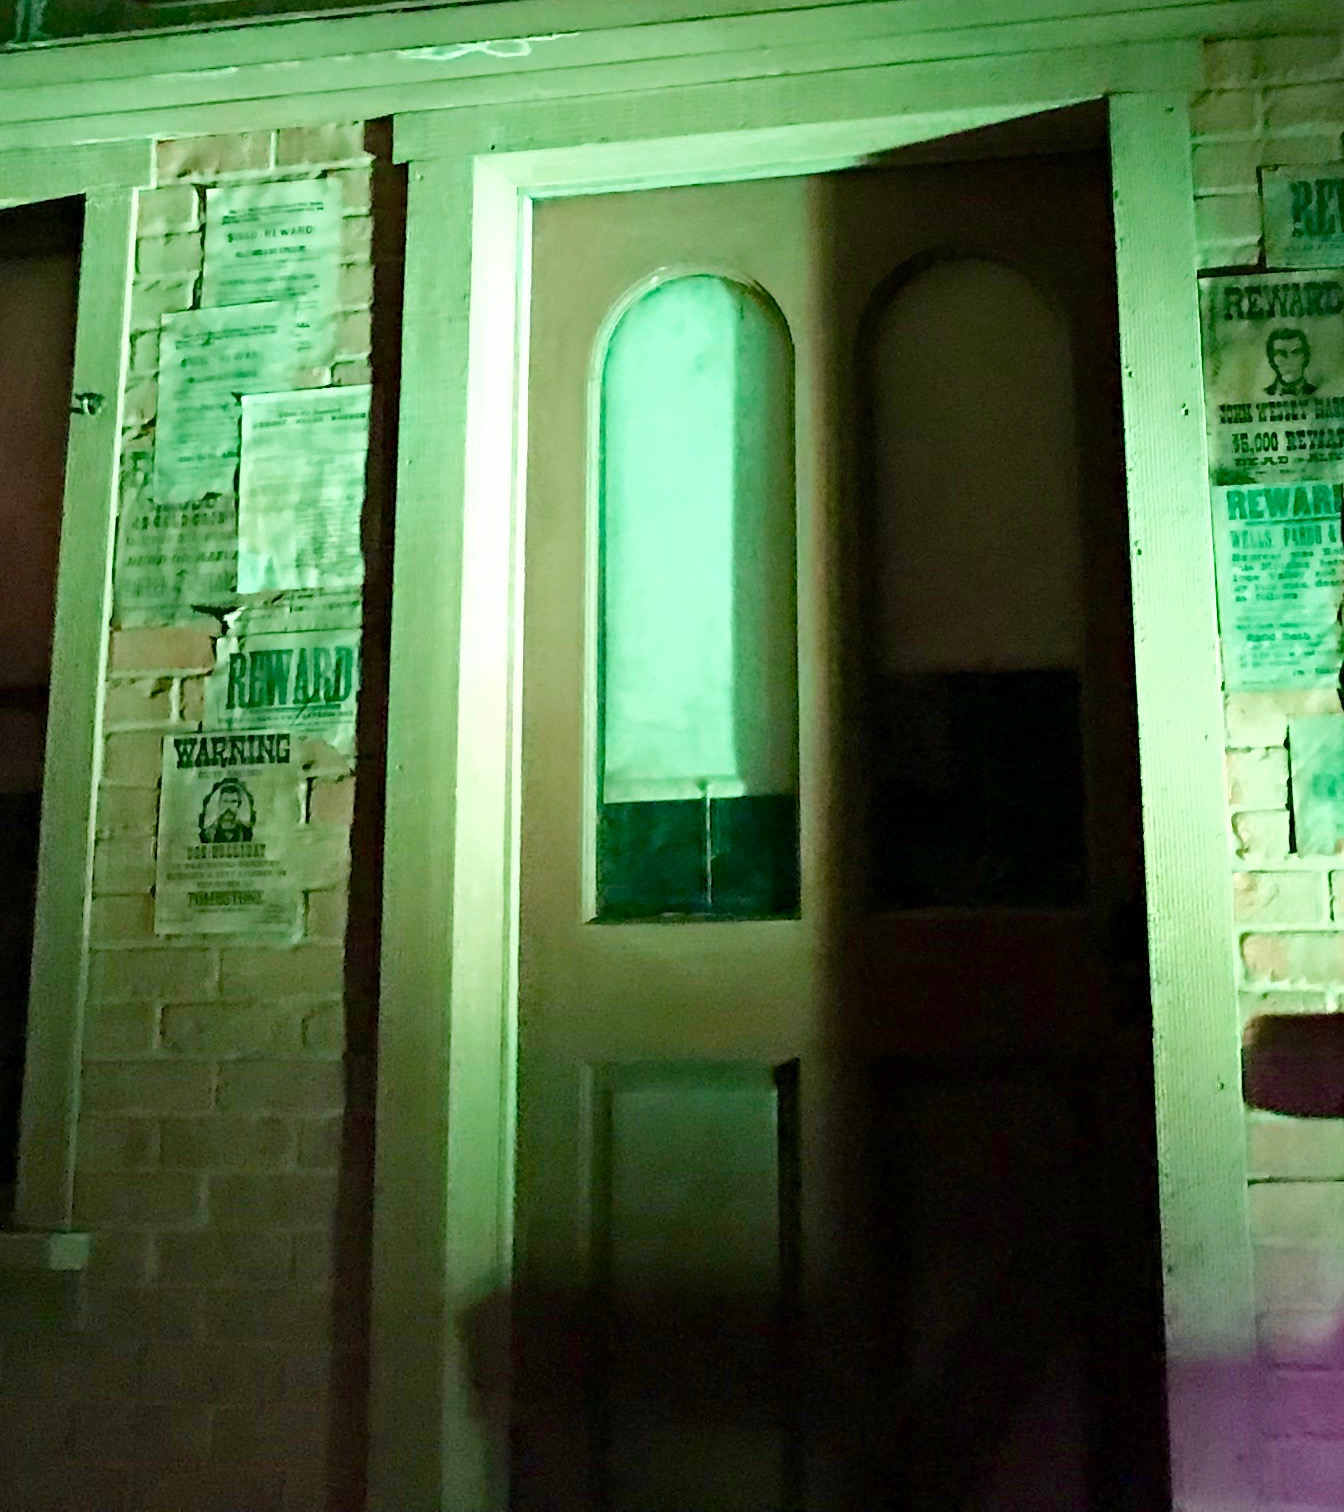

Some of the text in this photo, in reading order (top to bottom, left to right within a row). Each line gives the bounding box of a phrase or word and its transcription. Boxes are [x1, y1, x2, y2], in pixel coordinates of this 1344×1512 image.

[1223, 281, 1344, 320] REWARD
[226, 646, 353, 710] REWARD
[174, 733, 290, 769] WARNING
